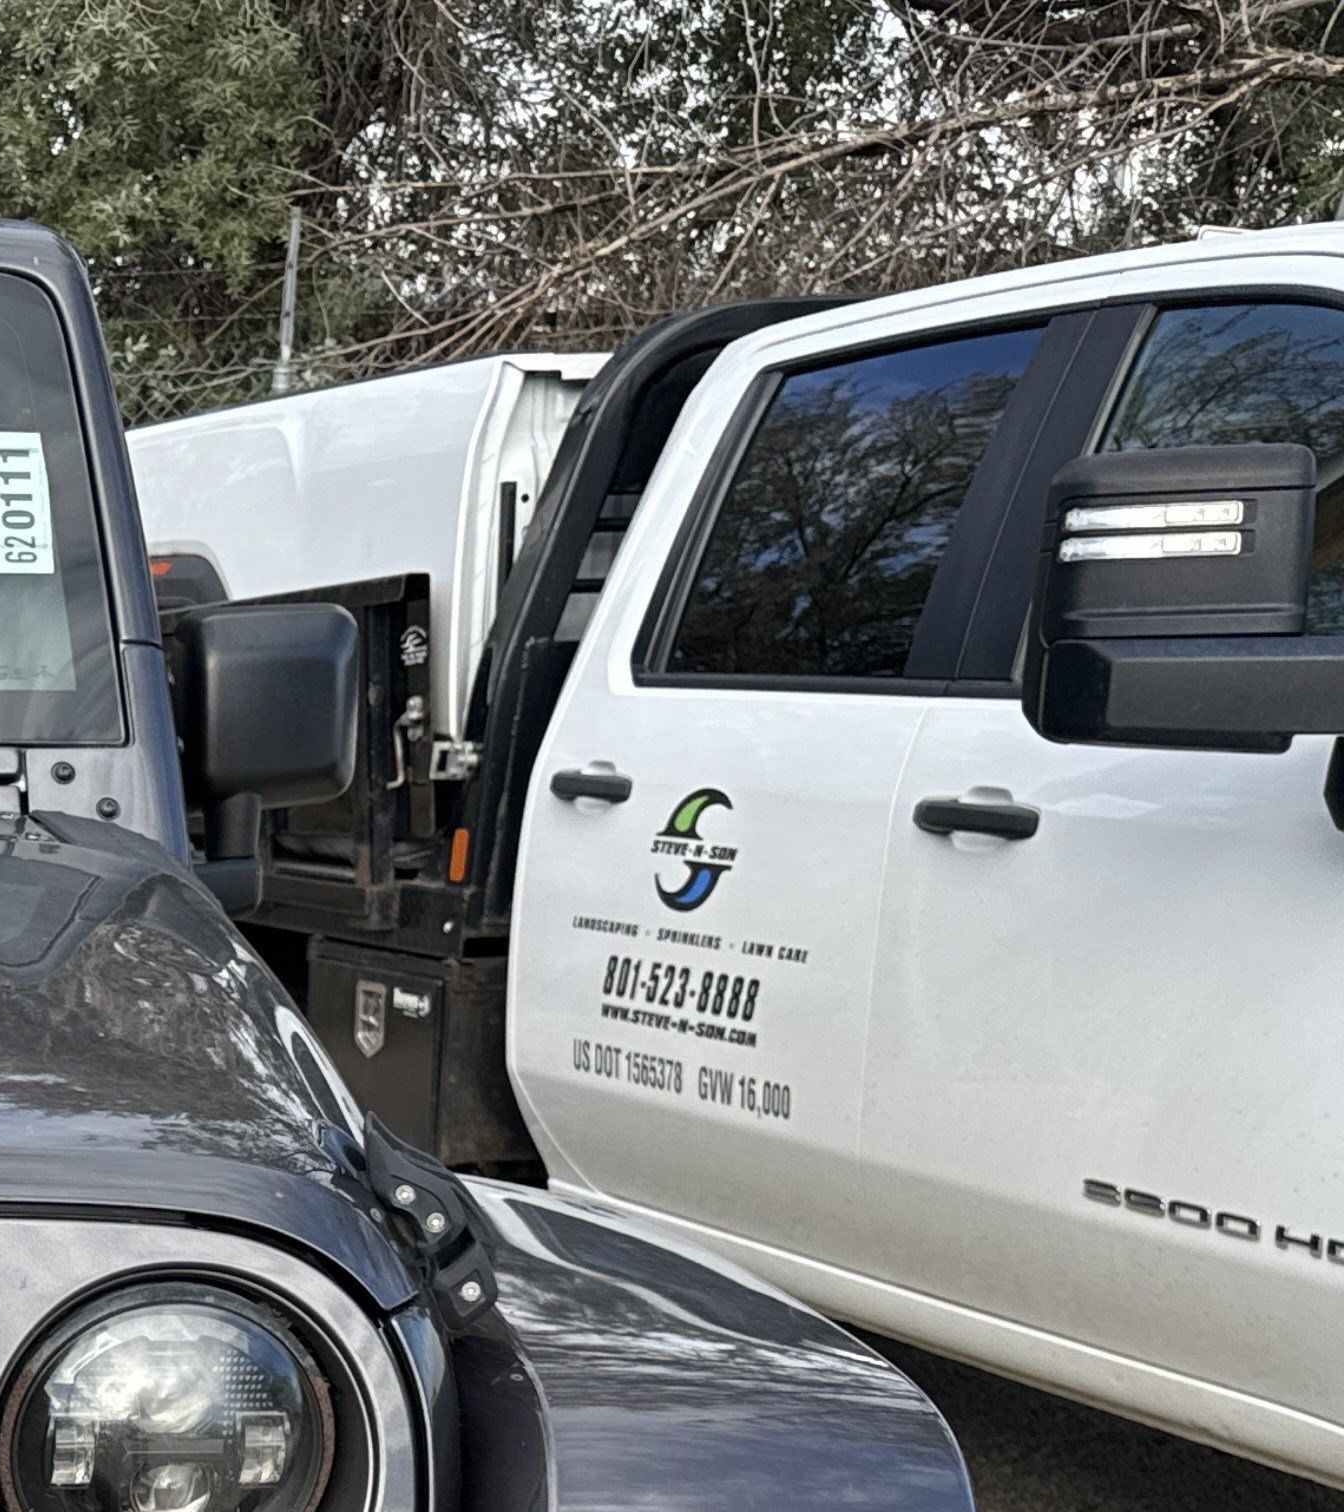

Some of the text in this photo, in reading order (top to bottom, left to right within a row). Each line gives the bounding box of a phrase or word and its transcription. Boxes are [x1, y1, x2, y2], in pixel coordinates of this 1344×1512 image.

[572, 913, 810, 965] LANDSCAPING SPRINKLERS LAWN CARE
[573, 1037, 792, 1120] US DOT 1565378 GVW 16,000
